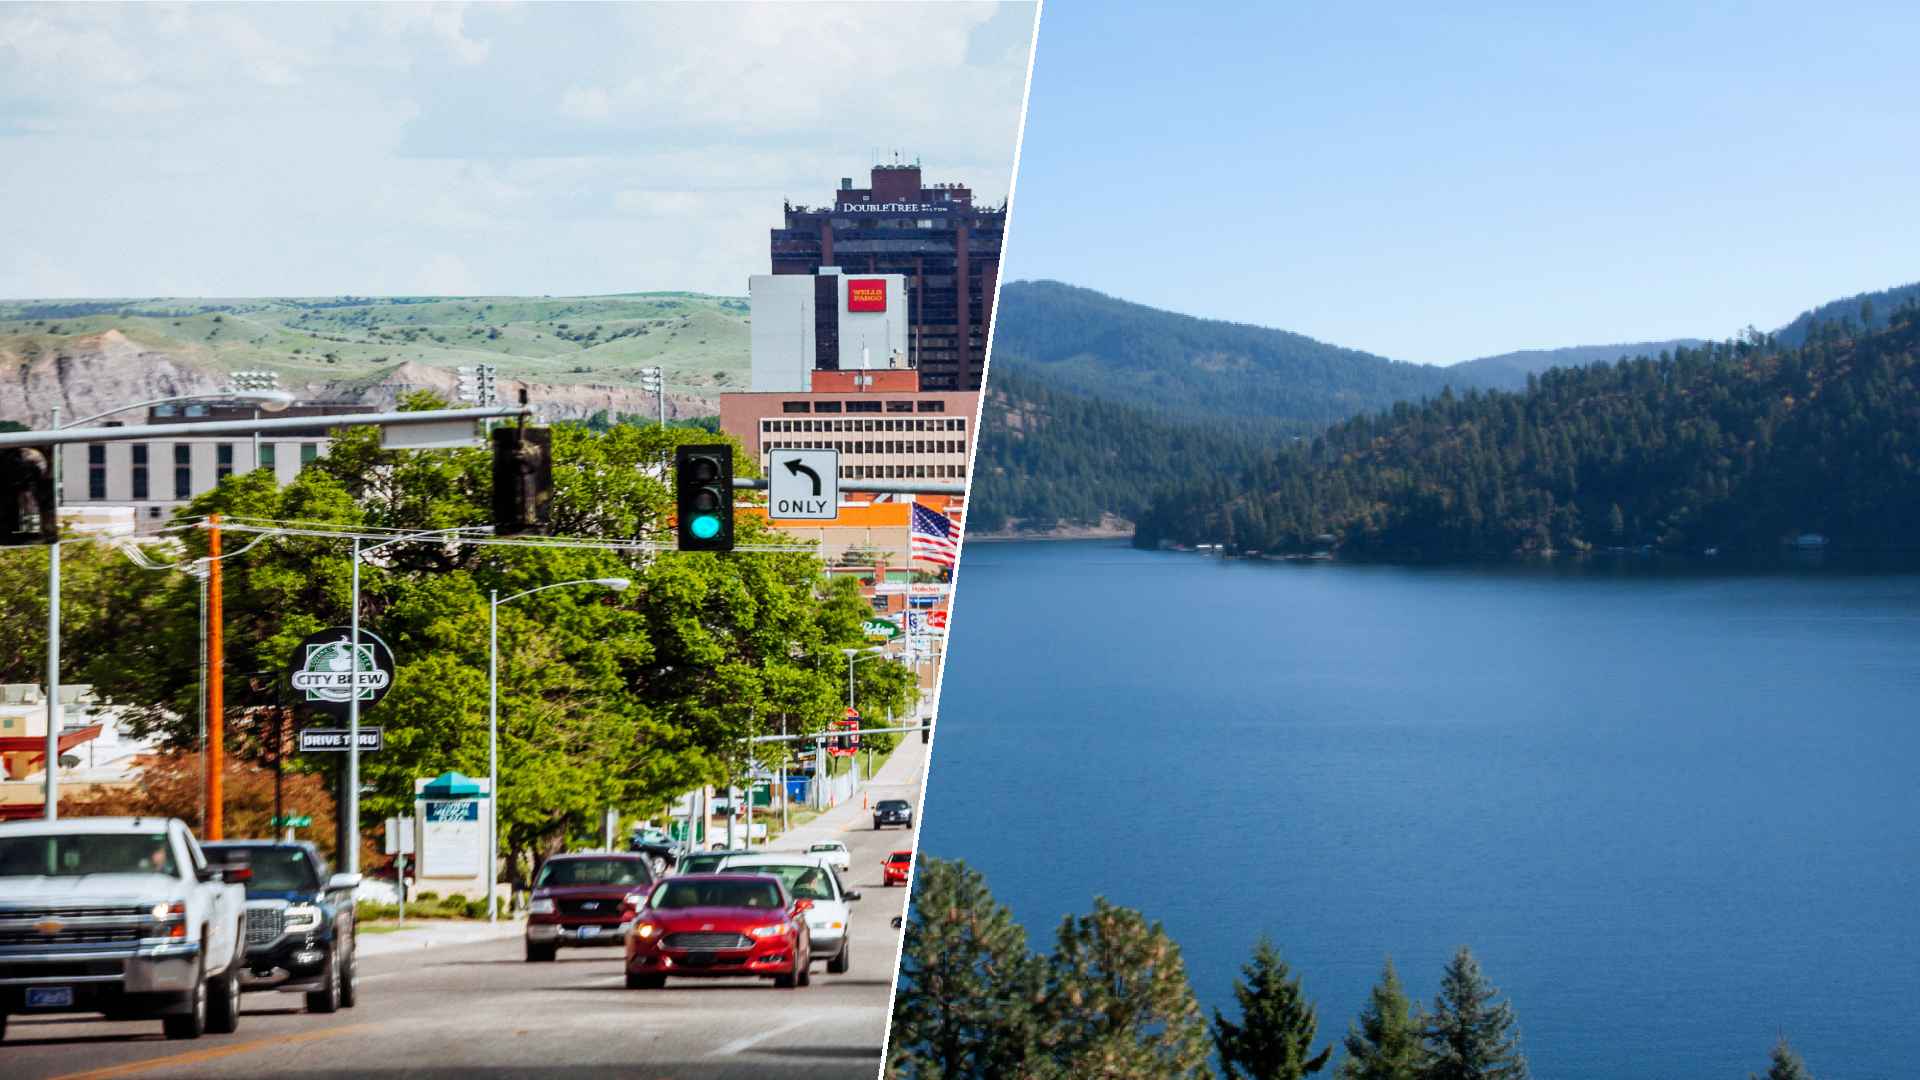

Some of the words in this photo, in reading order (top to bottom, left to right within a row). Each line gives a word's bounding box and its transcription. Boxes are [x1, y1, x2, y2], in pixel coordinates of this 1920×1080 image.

[778, 499, 827, 513] ONLY
[296, 674, 332, 685] CITY
[303, 734, 341, 746] DRIVE
[342, 734, 377, 745] TRU
